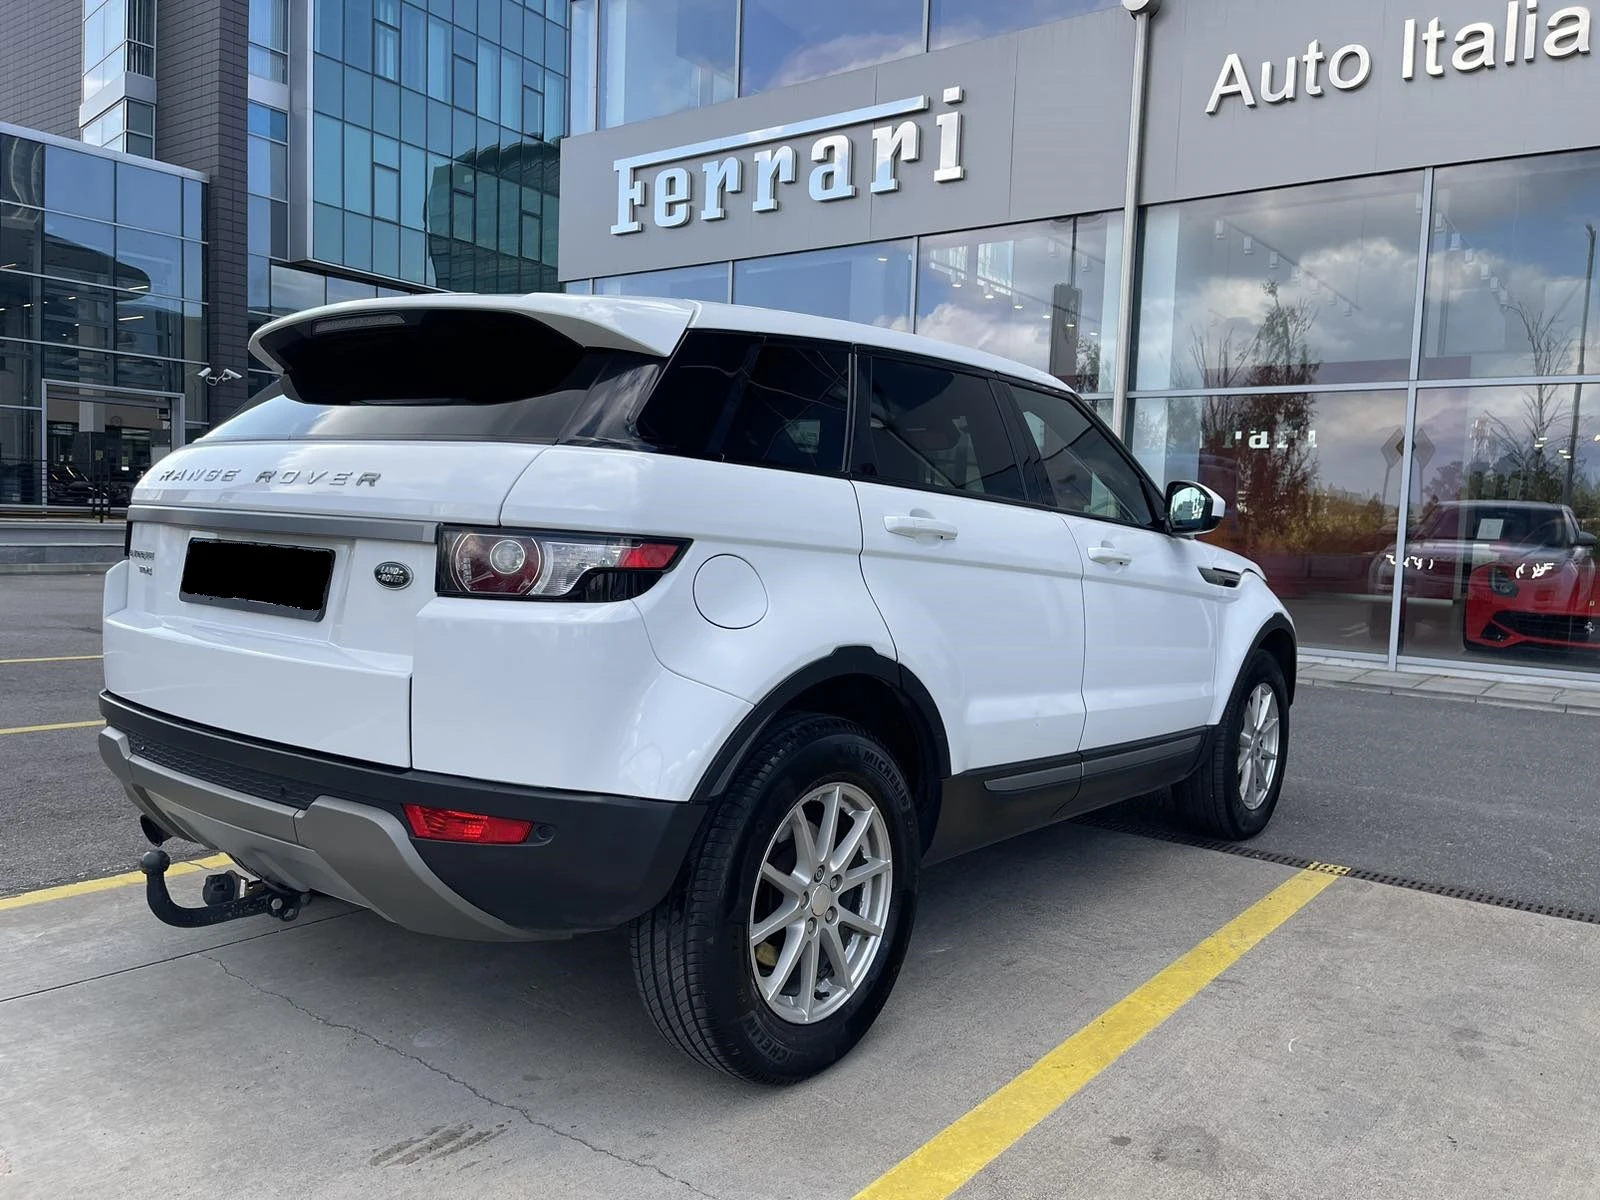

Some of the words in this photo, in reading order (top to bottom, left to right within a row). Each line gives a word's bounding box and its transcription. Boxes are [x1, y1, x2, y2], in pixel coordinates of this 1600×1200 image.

[1205, 39, 1372, 115] Auto
[1402, 0, 1591, 80] Italia
[610, 86, 964, 235] Ferrari
[158, 468, 242, 482] RANGE
[255, 470, 382, 487] ROVER
[380, 566, 399, 574] LAND
[381, 574, 404, 583] ROVER
[744, 1014, 799, 1064] ICHELIN
